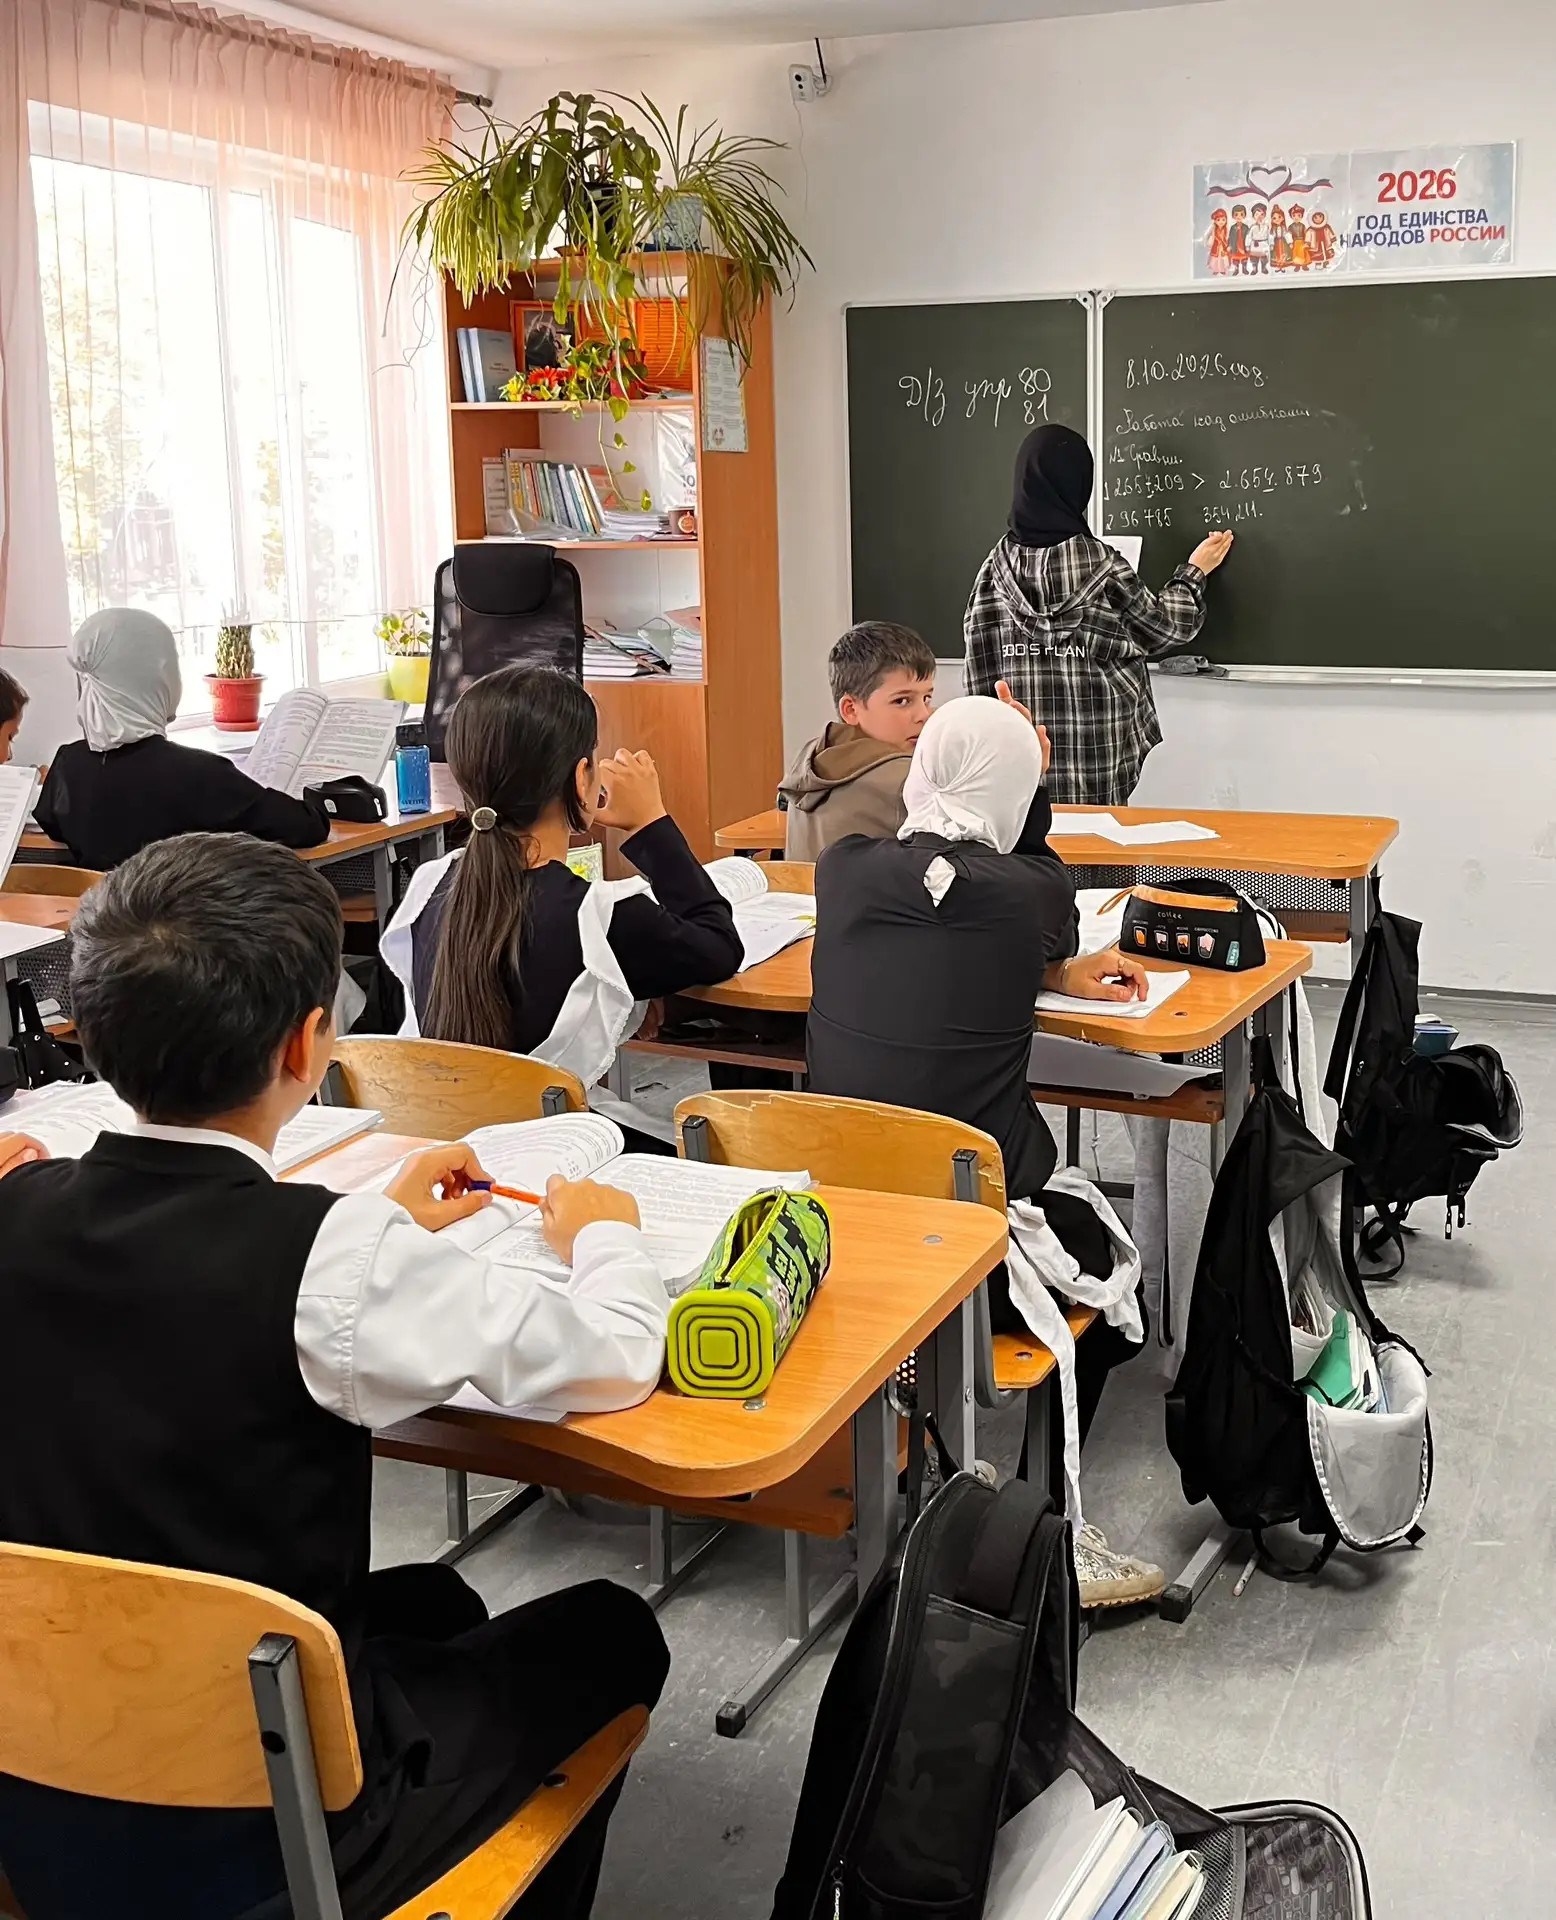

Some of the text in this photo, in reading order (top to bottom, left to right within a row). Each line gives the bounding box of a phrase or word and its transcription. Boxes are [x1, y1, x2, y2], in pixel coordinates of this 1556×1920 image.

[1377, 168, 1457, 203] 2026
[1357, 208, 1489, 231] ГОД ЕДИНСТВА
[1339, 225, 1506, 248] НАРОДОВ РОССИИ
[1017, 366, 1052, 395] 80
[1023, 393, 1049, 425] 81
[1115, 408, 1184, 435] Работа
